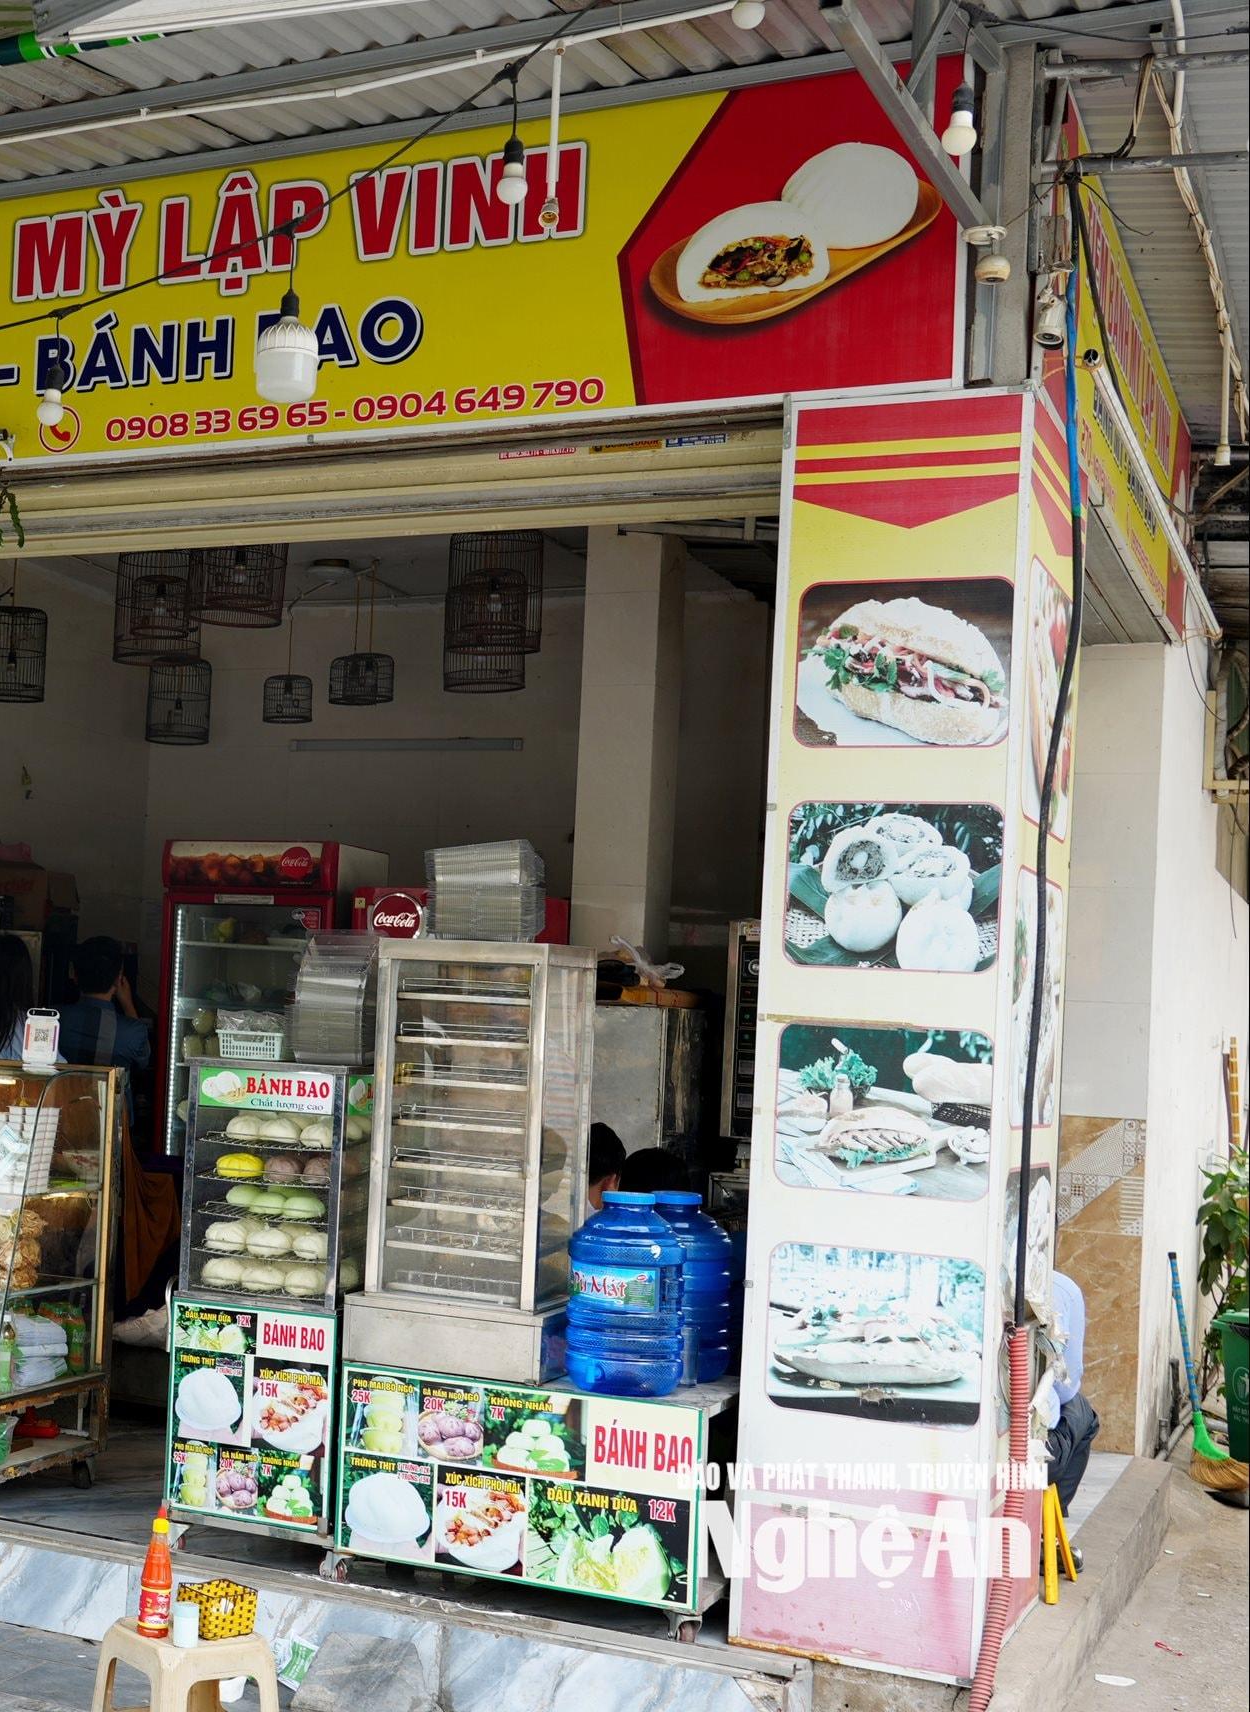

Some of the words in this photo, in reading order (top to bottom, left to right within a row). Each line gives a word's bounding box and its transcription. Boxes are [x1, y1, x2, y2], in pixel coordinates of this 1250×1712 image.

[13, 188, 142, 302] MỲ
[159, 170, 328, 295] LẬP
[350, 140, 588, 261] VINH
[35, 309, 236, 397] BÁNH
[105, 412, 189, 442] 0908
[194, 409, 231, 436] 33
[237, 404, 280, 432] 69
[286, 401, 328, 428] 65
[353, 391, 447, 422] 0904
[454, 383, 526, 414] 649
[532, 377, 605, 409] 790
[374, 911, 417, 928] Coca-Cola
[246, 1073, 292, 1096] BÁNH
[296, 1080, 330, 1098] BAO
[250, 1097, 275, 1108] Chất
[276, 1100, 305, 1111] lượng
[263, 1319, 297, 1348] BÁNH
[300, 1327, 325, 1351] BAO
[260, 1368, 274, 1380] XÚC
[309, 1374, 323, 1387] MAI
[260, 1382, 278, 1397] 15K
[351, 1389, 371, 1404] 25K
[424, 1397, 445, 1411] 20K
[490, 1406, 505, 1421] 7K
[594, 1418, 647, 1469] BÁNH
[653, 1433, 694, 1474] BAO
[262, 1464, 272, 1476] 7K
[445, 1471, 462, 1485] XÚC
[464, 1474, 484, 1489] XÍCH
[504, 1480, 521, 1494] MAI
[445, 1489, 467, 1508] 15K
[547, 1486, 572, 1505] ĐẬU
[648, 1499, 677, 1523] 12K
